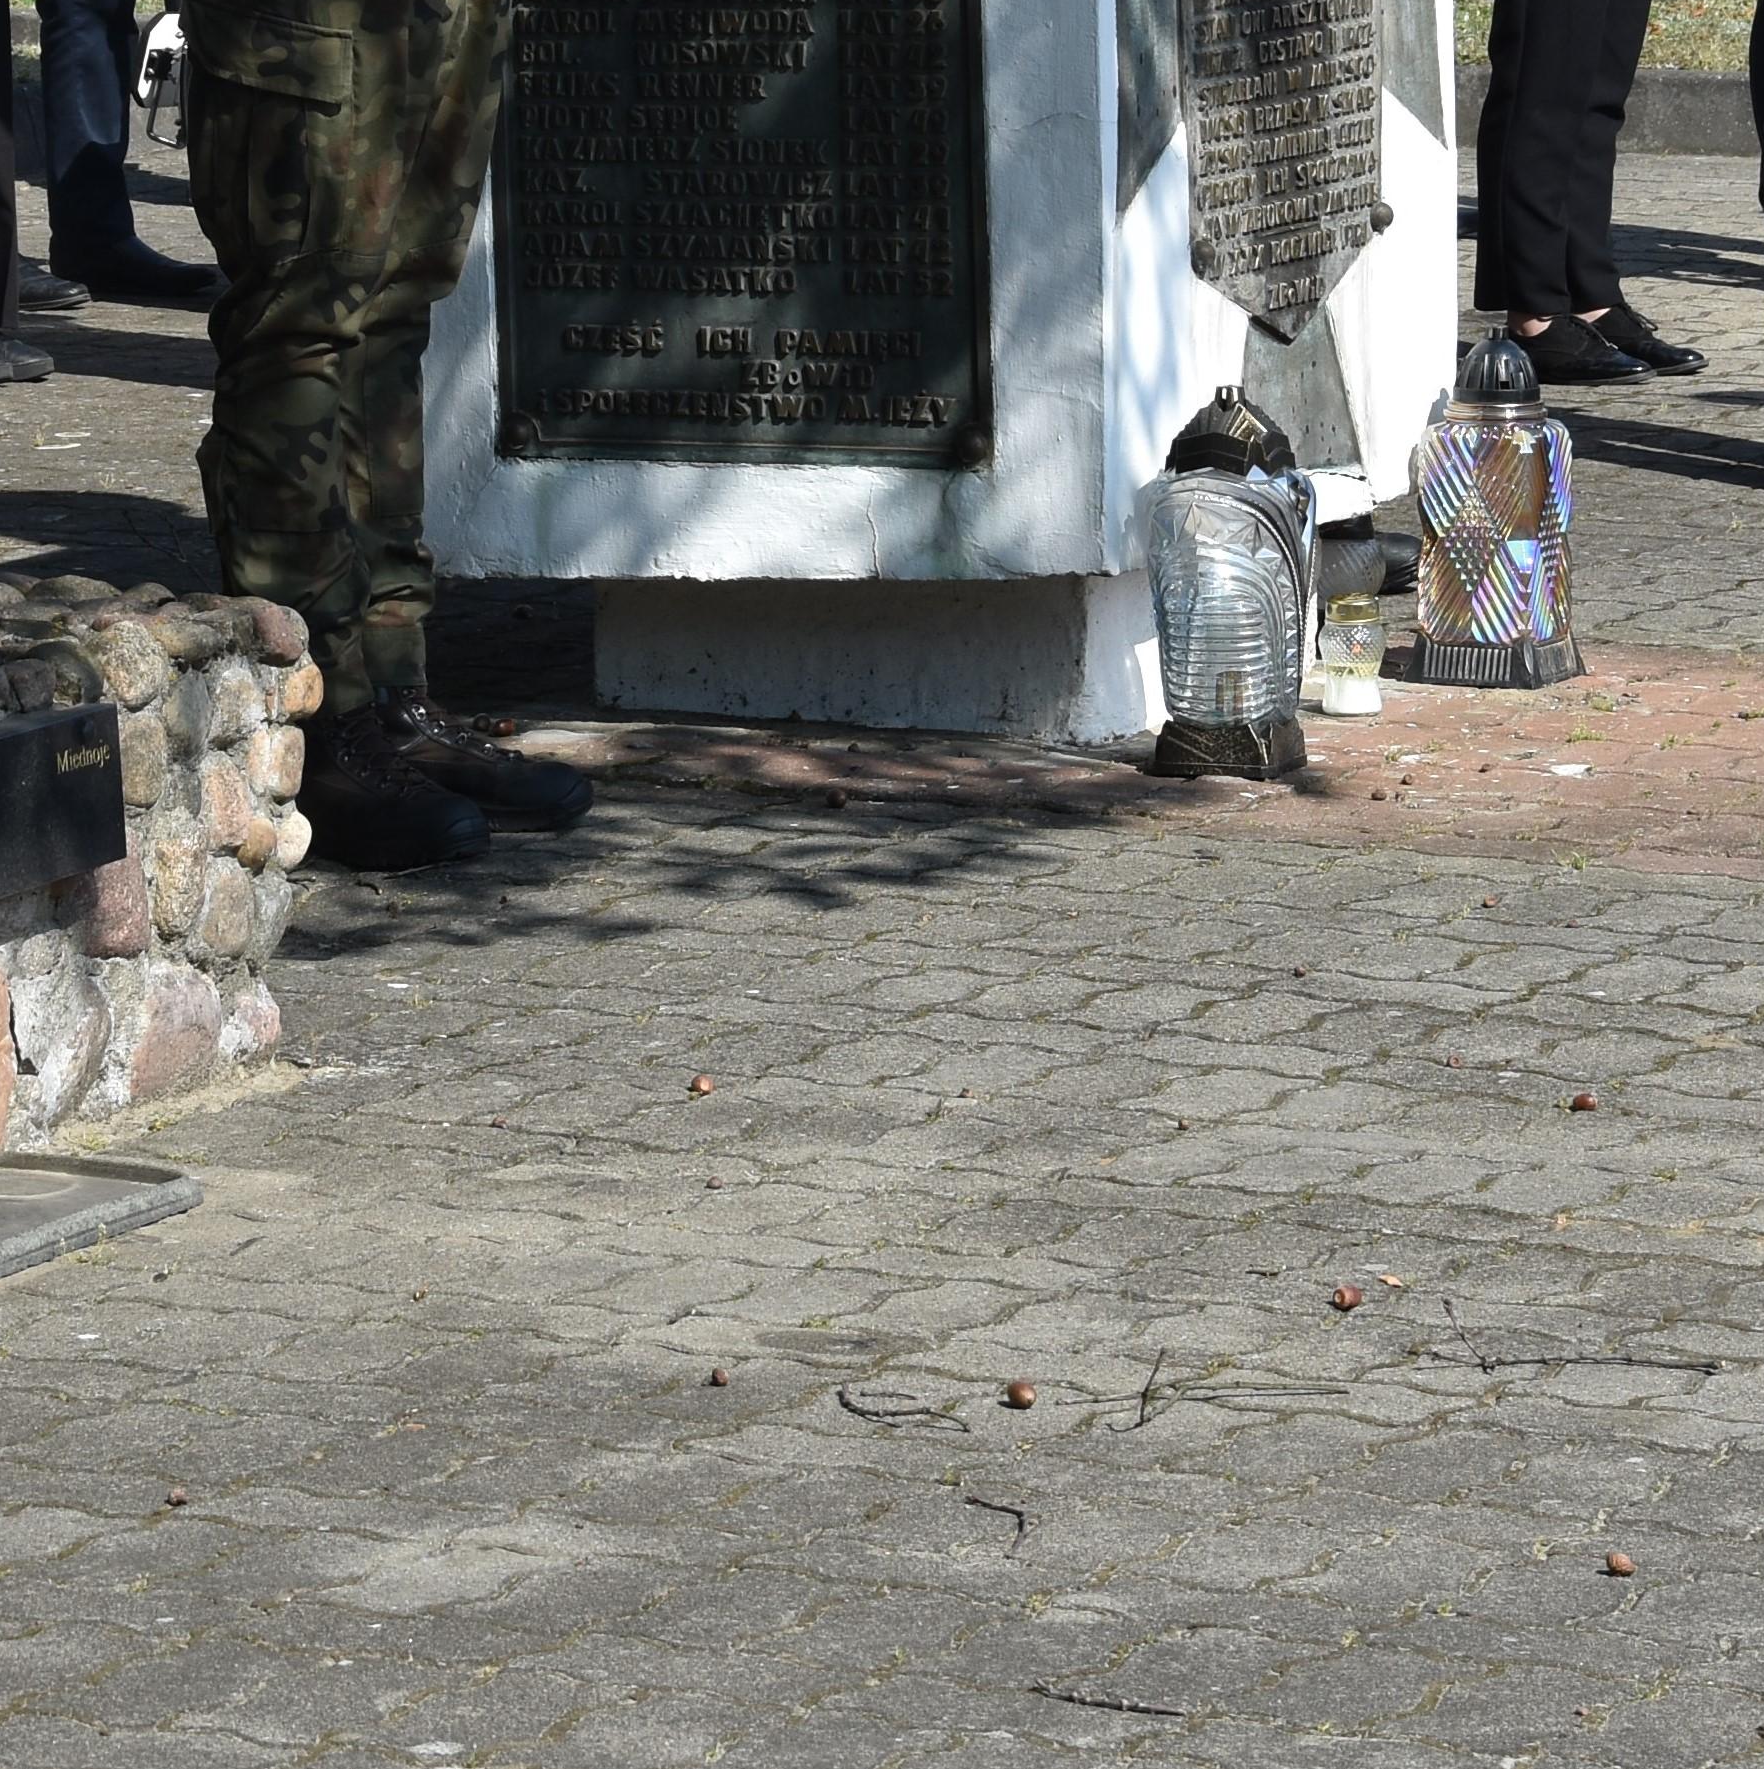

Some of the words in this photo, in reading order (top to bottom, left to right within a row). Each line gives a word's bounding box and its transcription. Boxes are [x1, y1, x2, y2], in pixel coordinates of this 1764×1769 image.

[566, 320, 665, 353] CZEŚĆ
[698, 326, 751, 356] ICH
[56, 740, 110, 775] Miednoje
